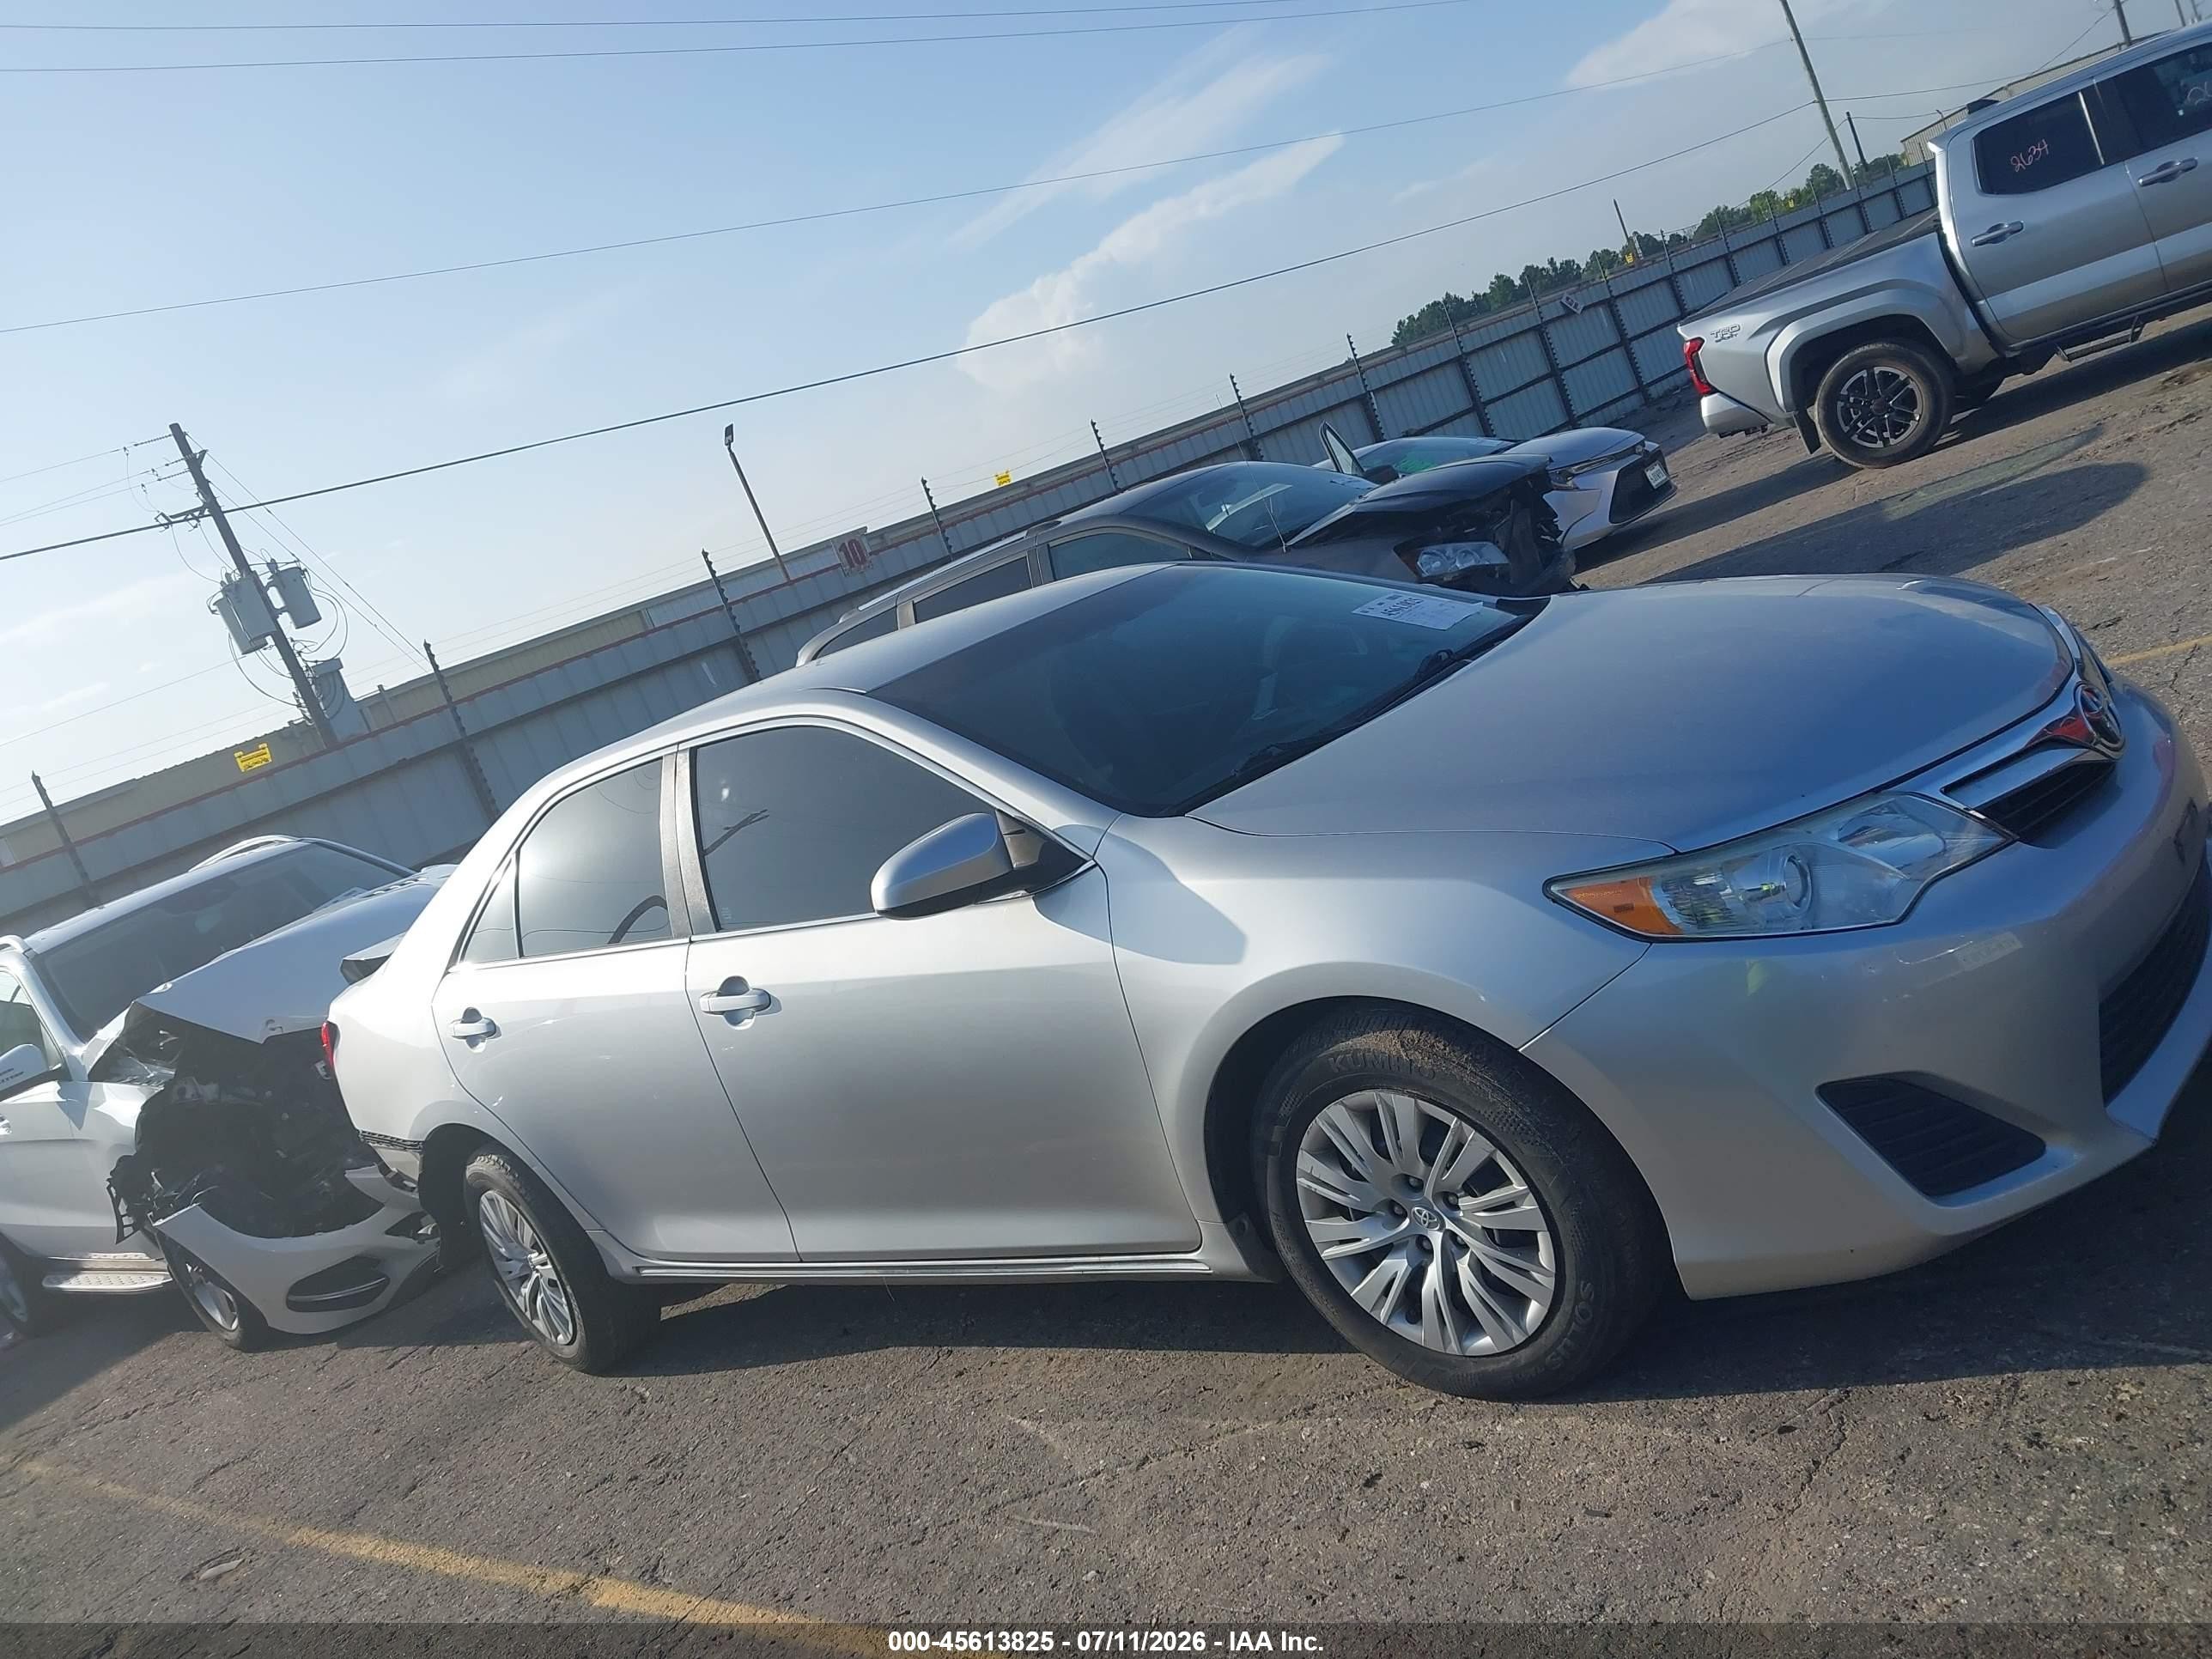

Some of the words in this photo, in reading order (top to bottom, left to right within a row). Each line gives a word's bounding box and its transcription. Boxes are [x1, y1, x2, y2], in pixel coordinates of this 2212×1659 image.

[2009, 138, 2050, 173] 2634
[1710, 323, 1741, 338] TRD
[838, 538, 867, 568] 10
